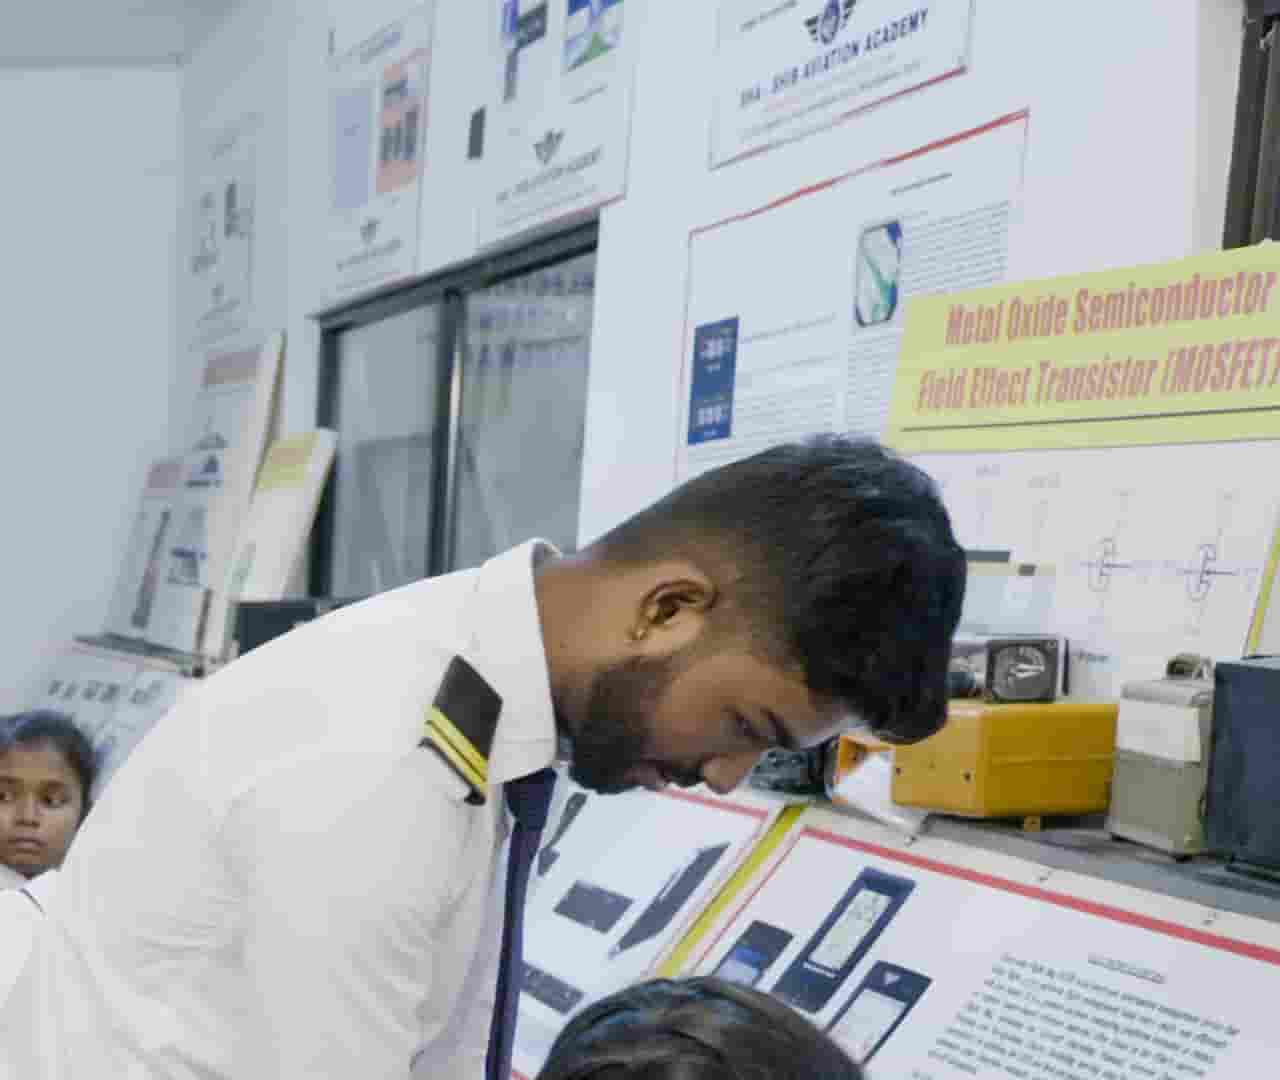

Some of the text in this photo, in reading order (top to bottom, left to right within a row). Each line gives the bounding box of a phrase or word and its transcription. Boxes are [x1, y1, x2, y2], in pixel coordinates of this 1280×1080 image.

[944, 270, 1278, 346] Metal Oxide Semiconductor
[913, 366, 967, 413] Field
[968, 365, 1034, 410] Effect
[1034, 352, 1159, 405] Transistor
